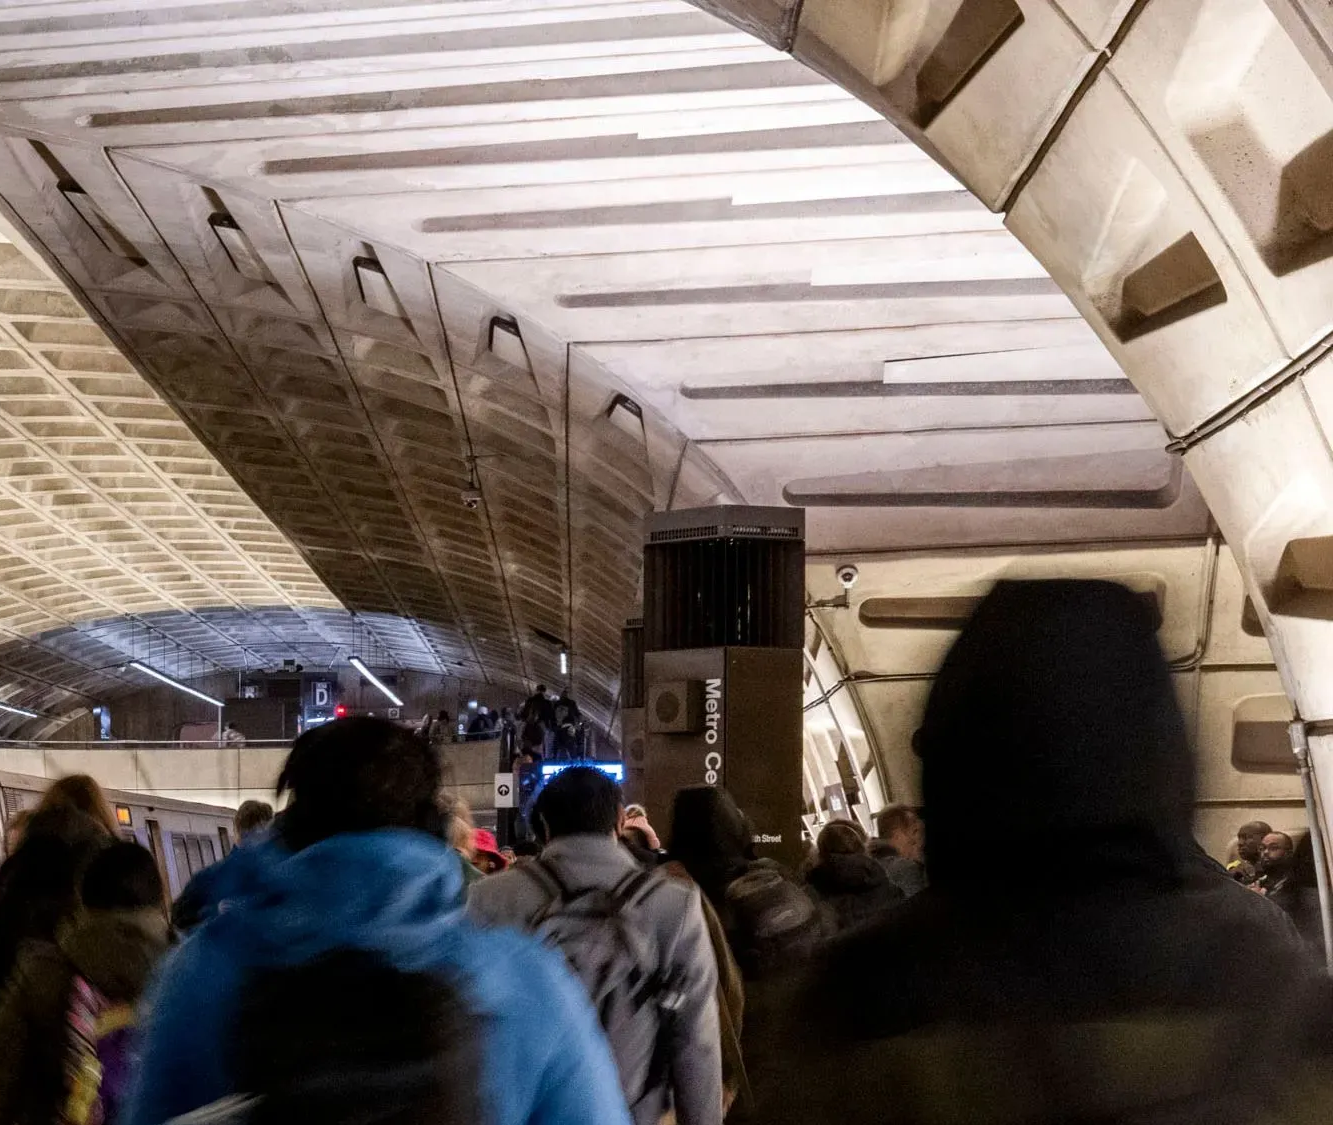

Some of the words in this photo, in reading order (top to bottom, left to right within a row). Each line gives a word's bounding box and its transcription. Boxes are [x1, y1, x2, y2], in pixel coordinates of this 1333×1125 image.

[705, 678, 721, 744] Metro
[705, 752, 721, 786] Ce
[762, 834, 782, 843] Street
